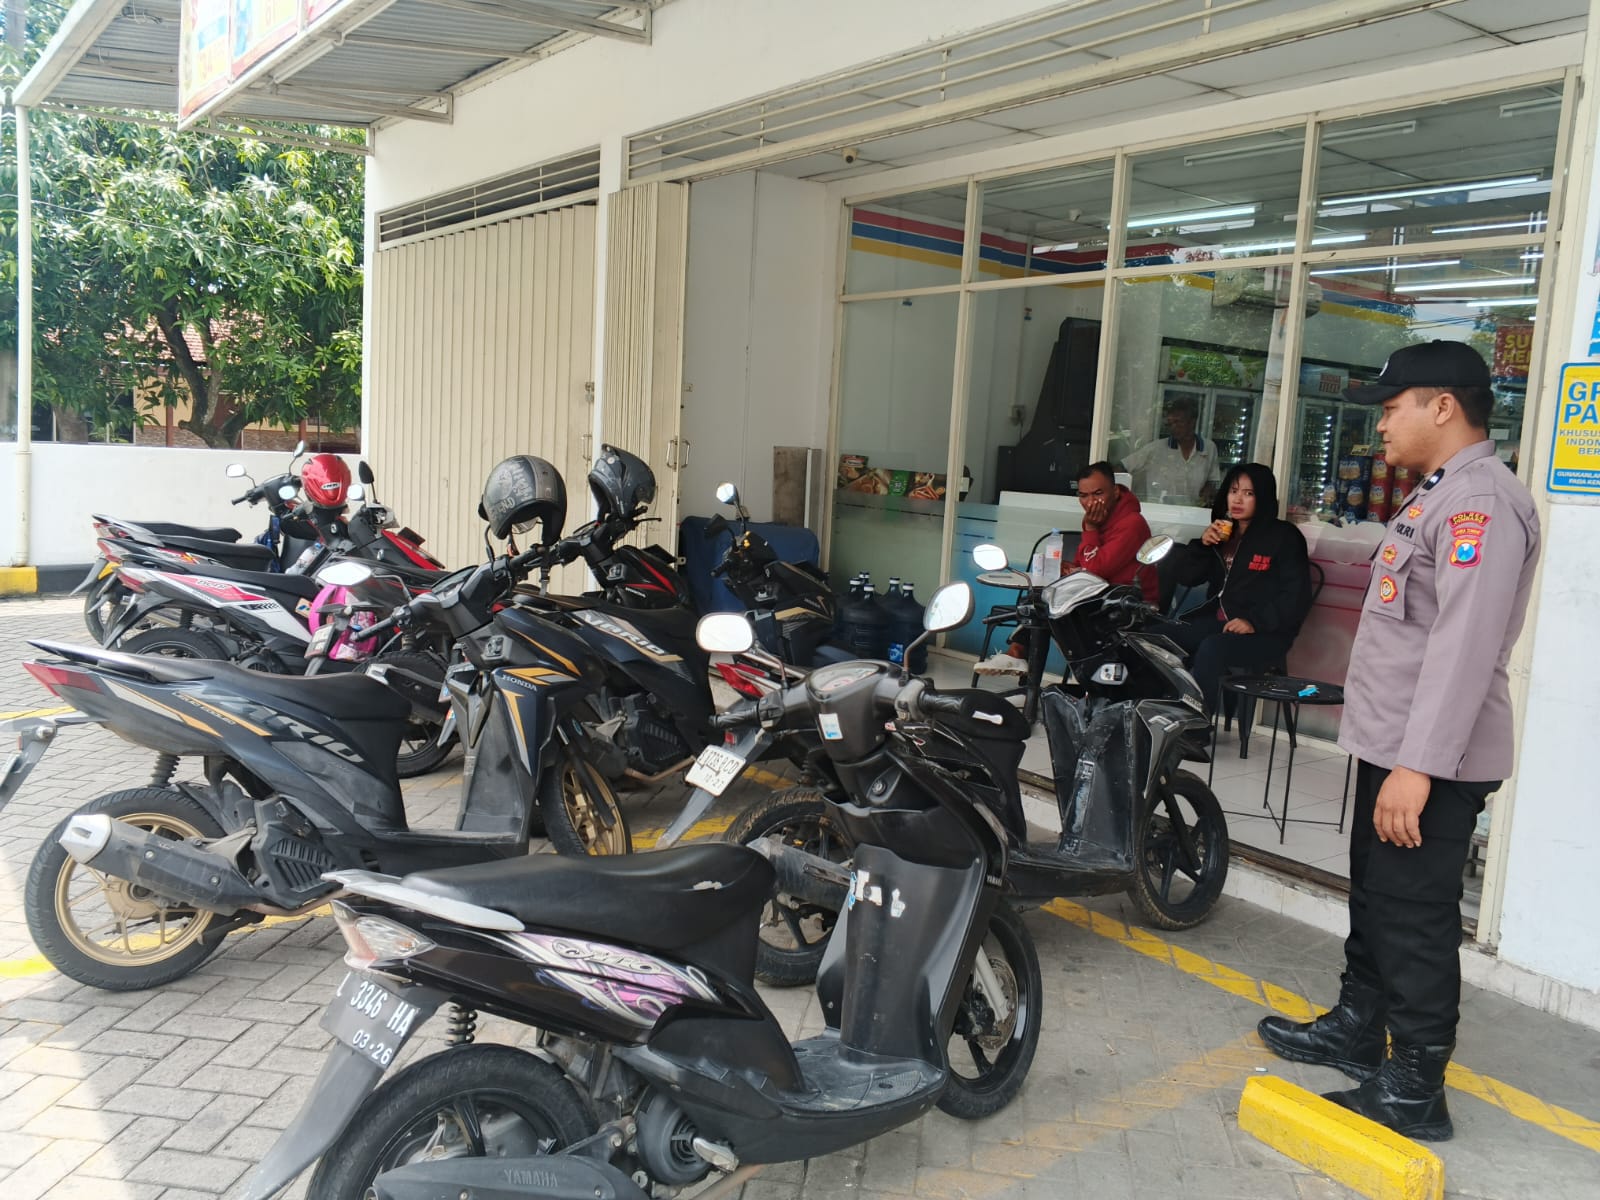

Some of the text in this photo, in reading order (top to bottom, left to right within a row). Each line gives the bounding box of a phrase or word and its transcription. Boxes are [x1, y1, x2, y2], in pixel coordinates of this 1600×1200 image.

[1560, 429, 1600, 437] KHUSU
[501, 674, 538, 692] HONDA
[336, 971, 416, 1037] L 3346 HA
[503, 1167, 558, 1188] YAMAHA
